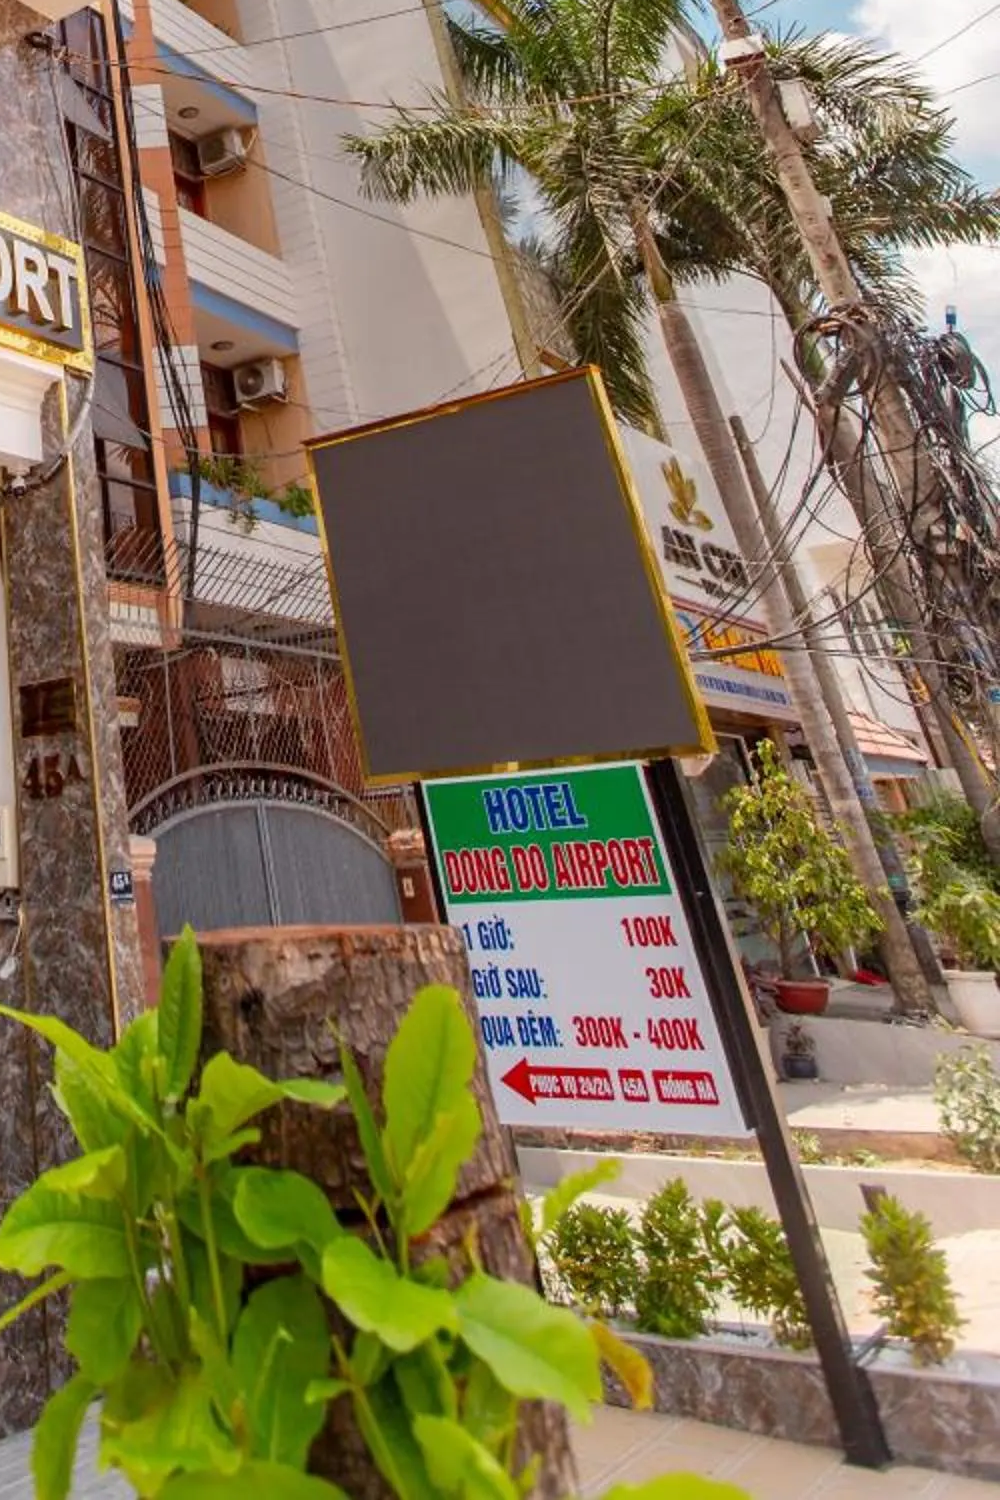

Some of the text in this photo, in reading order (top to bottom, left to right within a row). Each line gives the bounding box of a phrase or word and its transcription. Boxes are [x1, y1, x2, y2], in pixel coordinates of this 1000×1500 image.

[483, 782, 587, 834] HOTEL
[443, 837, 662, 896] DONG DO AIRPORT
[463, 923, 473, 951] 1
[622, 916, 678, 949] 100K
[506, 969, 548, 999] SAU:
[646, 967, 692, 999] 30K
[480, 1015, 515, 1050] QUA
[572, 1015, 629, 1049] 300K
[647, 1017, 705, 1051] 400K
